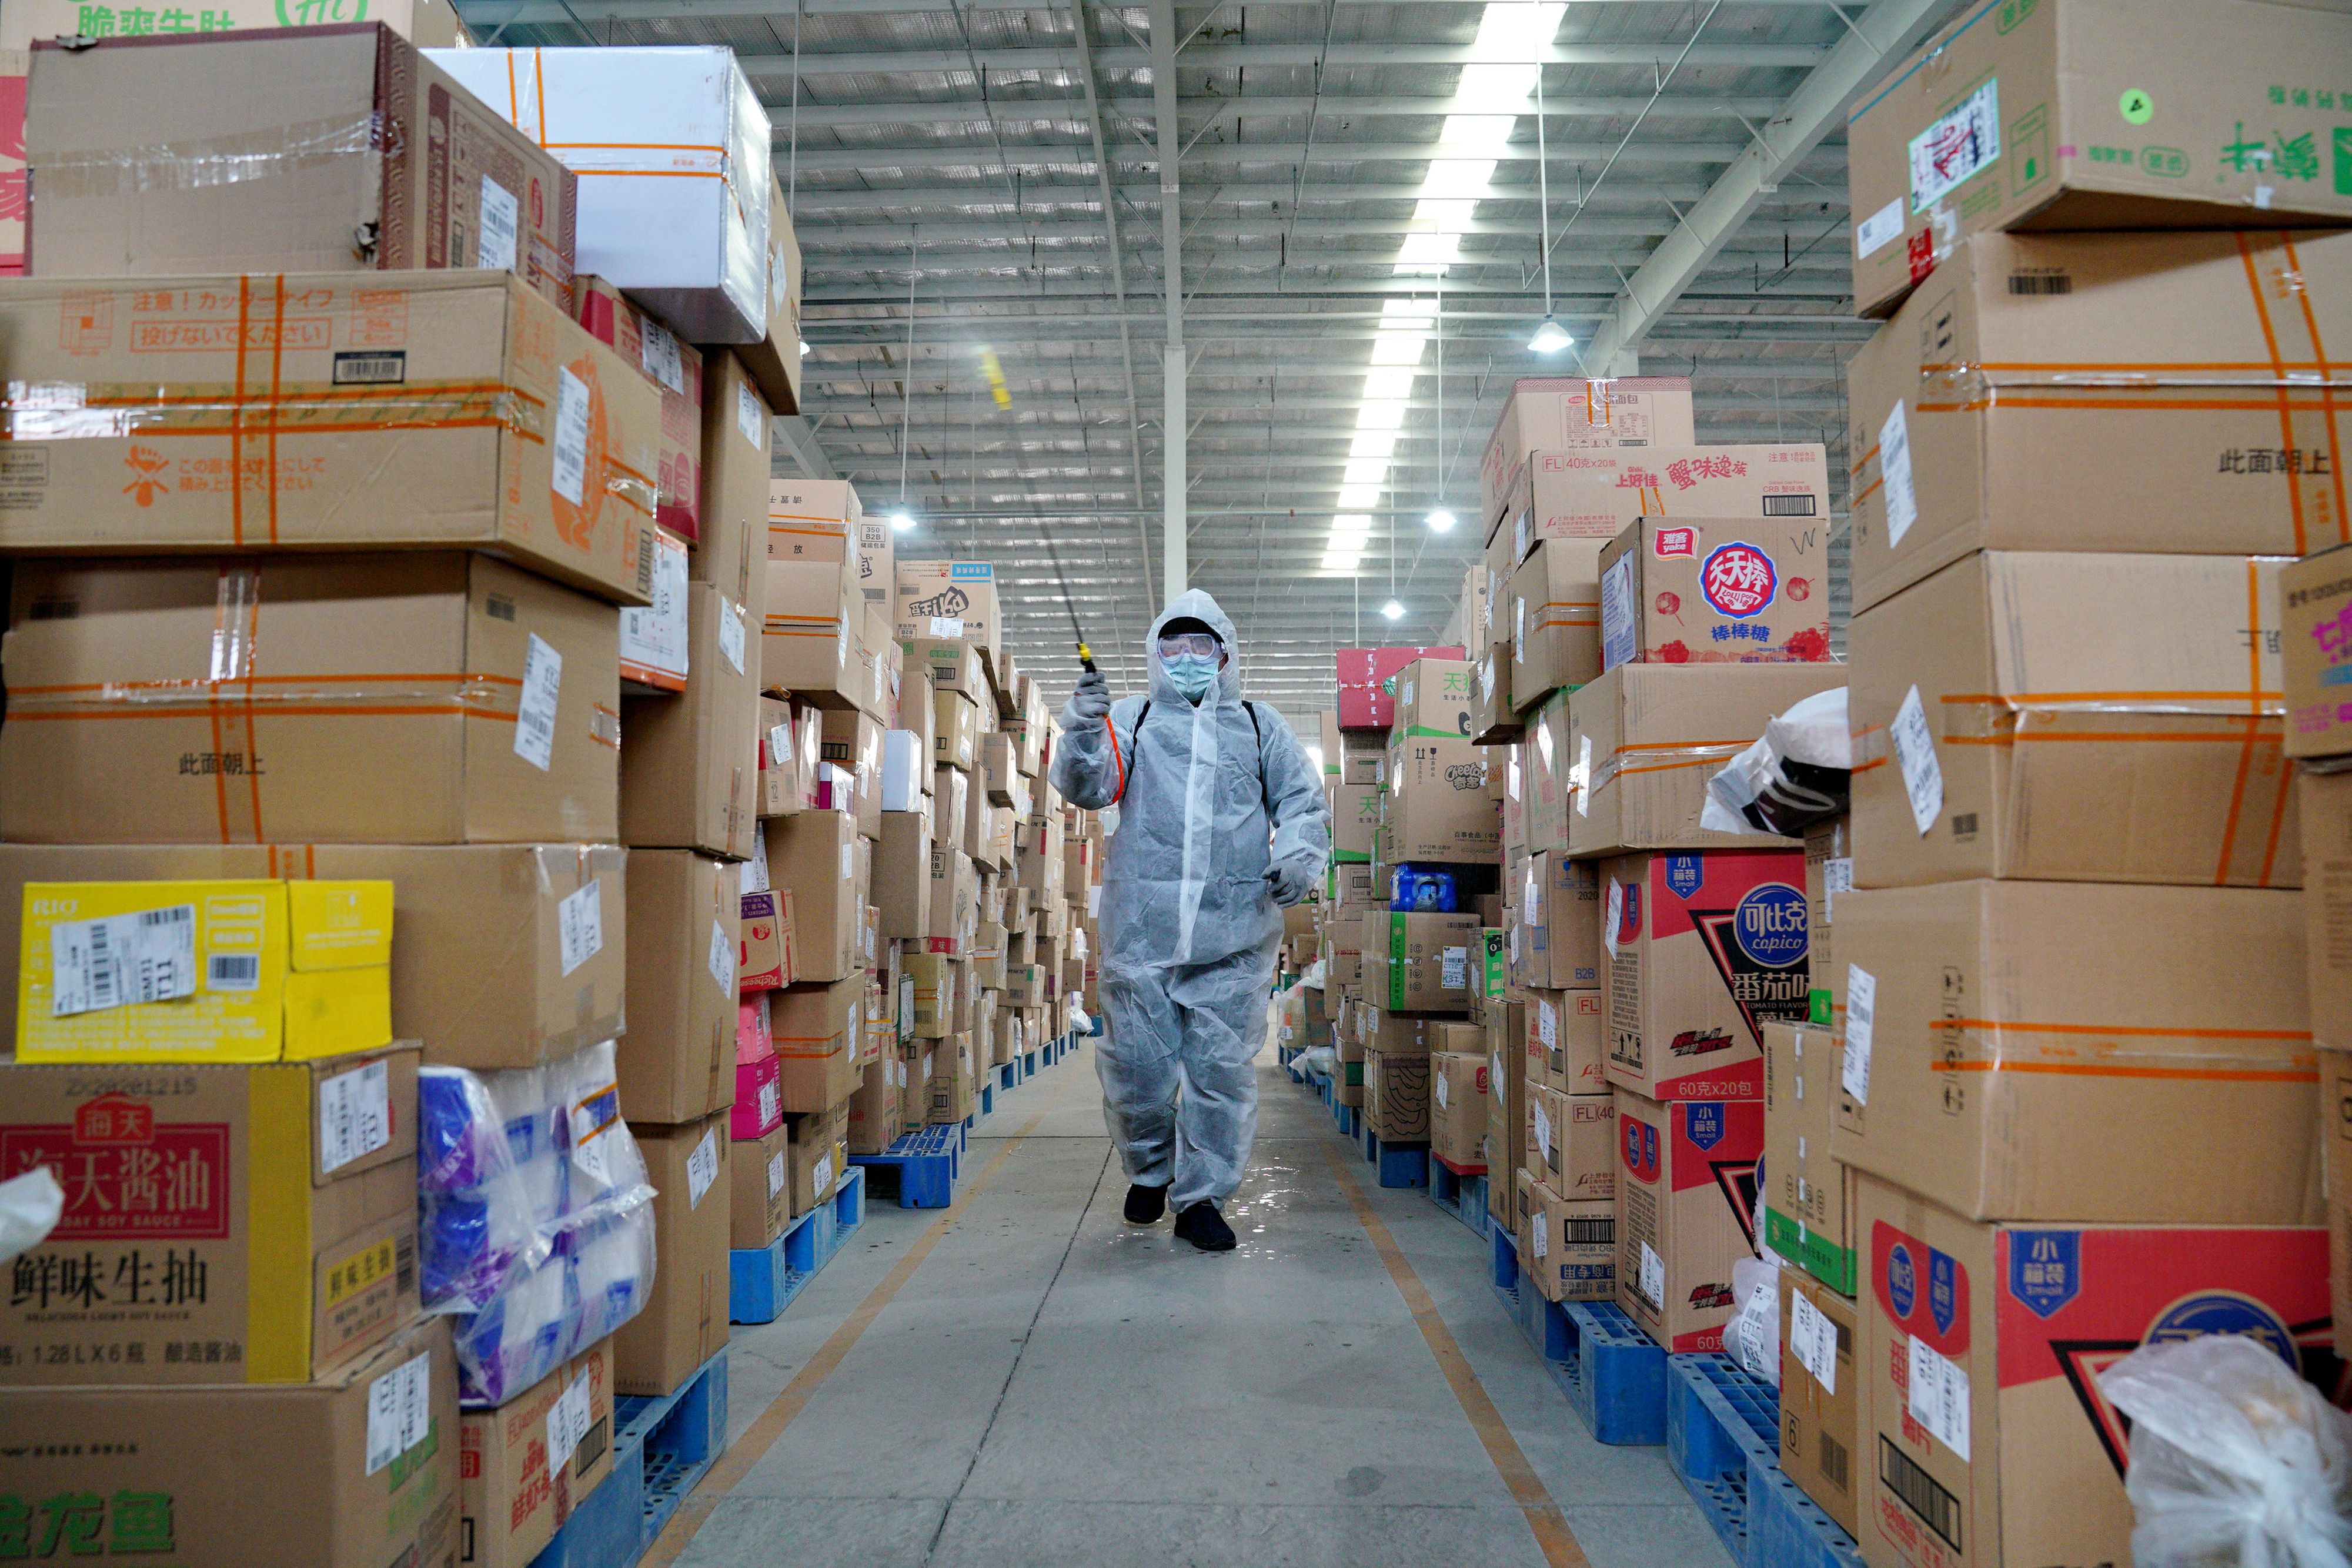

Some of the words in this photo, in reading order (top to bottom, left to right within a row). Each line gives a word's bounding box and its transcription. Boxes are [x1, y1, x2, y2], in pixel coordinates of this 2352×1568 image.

[2220, 121, 2320, 181] 蒙牛
[1545, 459, 1562, 469] FL
[2219, 448, 2331, 475] 此面朝上
[1615, 473, 1659, 488] 上好佳
[1663, 532, 1687, 544] 雅客
[1663, 543, 1686, 552] yake
[1709, 550, 1769, 594] 天天棒
[1711, 623, 1770, 642] 棒棒糖
[179, 752, 266, 775] 此面朝上
[1453, 775, 1481, 791] 奇多
[1359, 796, 1377, 815] 天
[1677, 856, 1691, 868] 小
[1673, 869, 1696, 880] 箱装
[32, 898, 78, 915] RIO
[1742, 901, 1808, 937] 可比克
[1575, 968, 1595, 979] B2B
[1580, 999, 1599, 1012] FL
[1679, 1081, 1752, 1096] 60克x20包
[1576, 1107, 1594, 1120] FL
[1699, 1106, 1713, 1119] 小
[1694, 1120, 1717, 1132] 箱装
[2032, 1237, 2057, 1261] 小
[10, 1248, 208, 1308] 鲜味生抽
